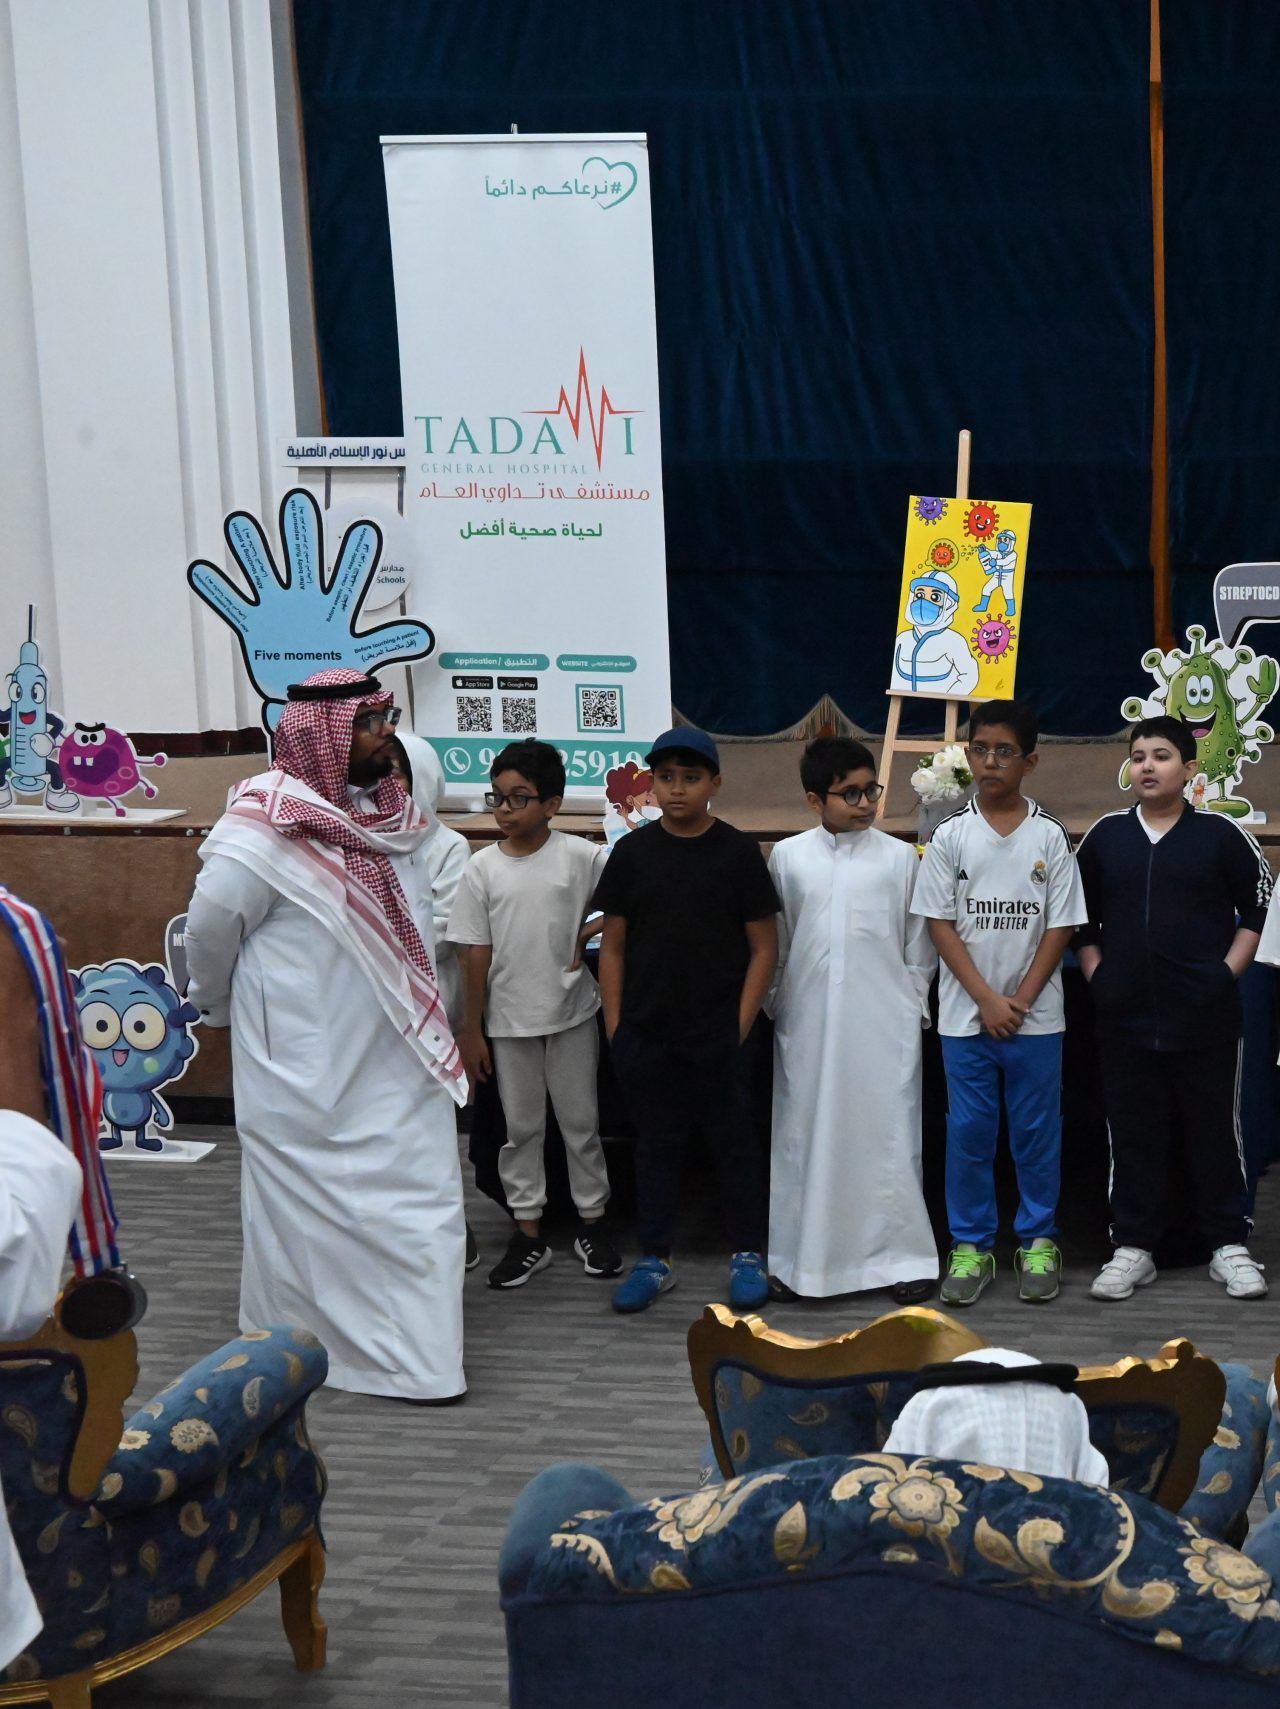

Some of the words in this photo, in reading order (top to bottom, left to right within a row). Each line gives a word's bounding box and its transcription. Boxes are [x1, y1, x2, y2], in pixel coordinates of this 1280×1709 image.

[371, 446, 388, 460] نور
[421, 463, 495, 474] GENERAL
[508, 463, 588, 475] HOSPITAL
[459, 517, 505, 540] أفضل
[508, 522, 557, 541] صحية
[561, 522, 603, 541] لحياة
[255, 650, 280, 660] Five
[285, 651, 342, 660] moments
[454, 658, 497, 666] Application
[967, 897, 1040, 915] Emirates
[976, 917, 990, 930] FLY
[993, 917, 1028, 930] BETTER
